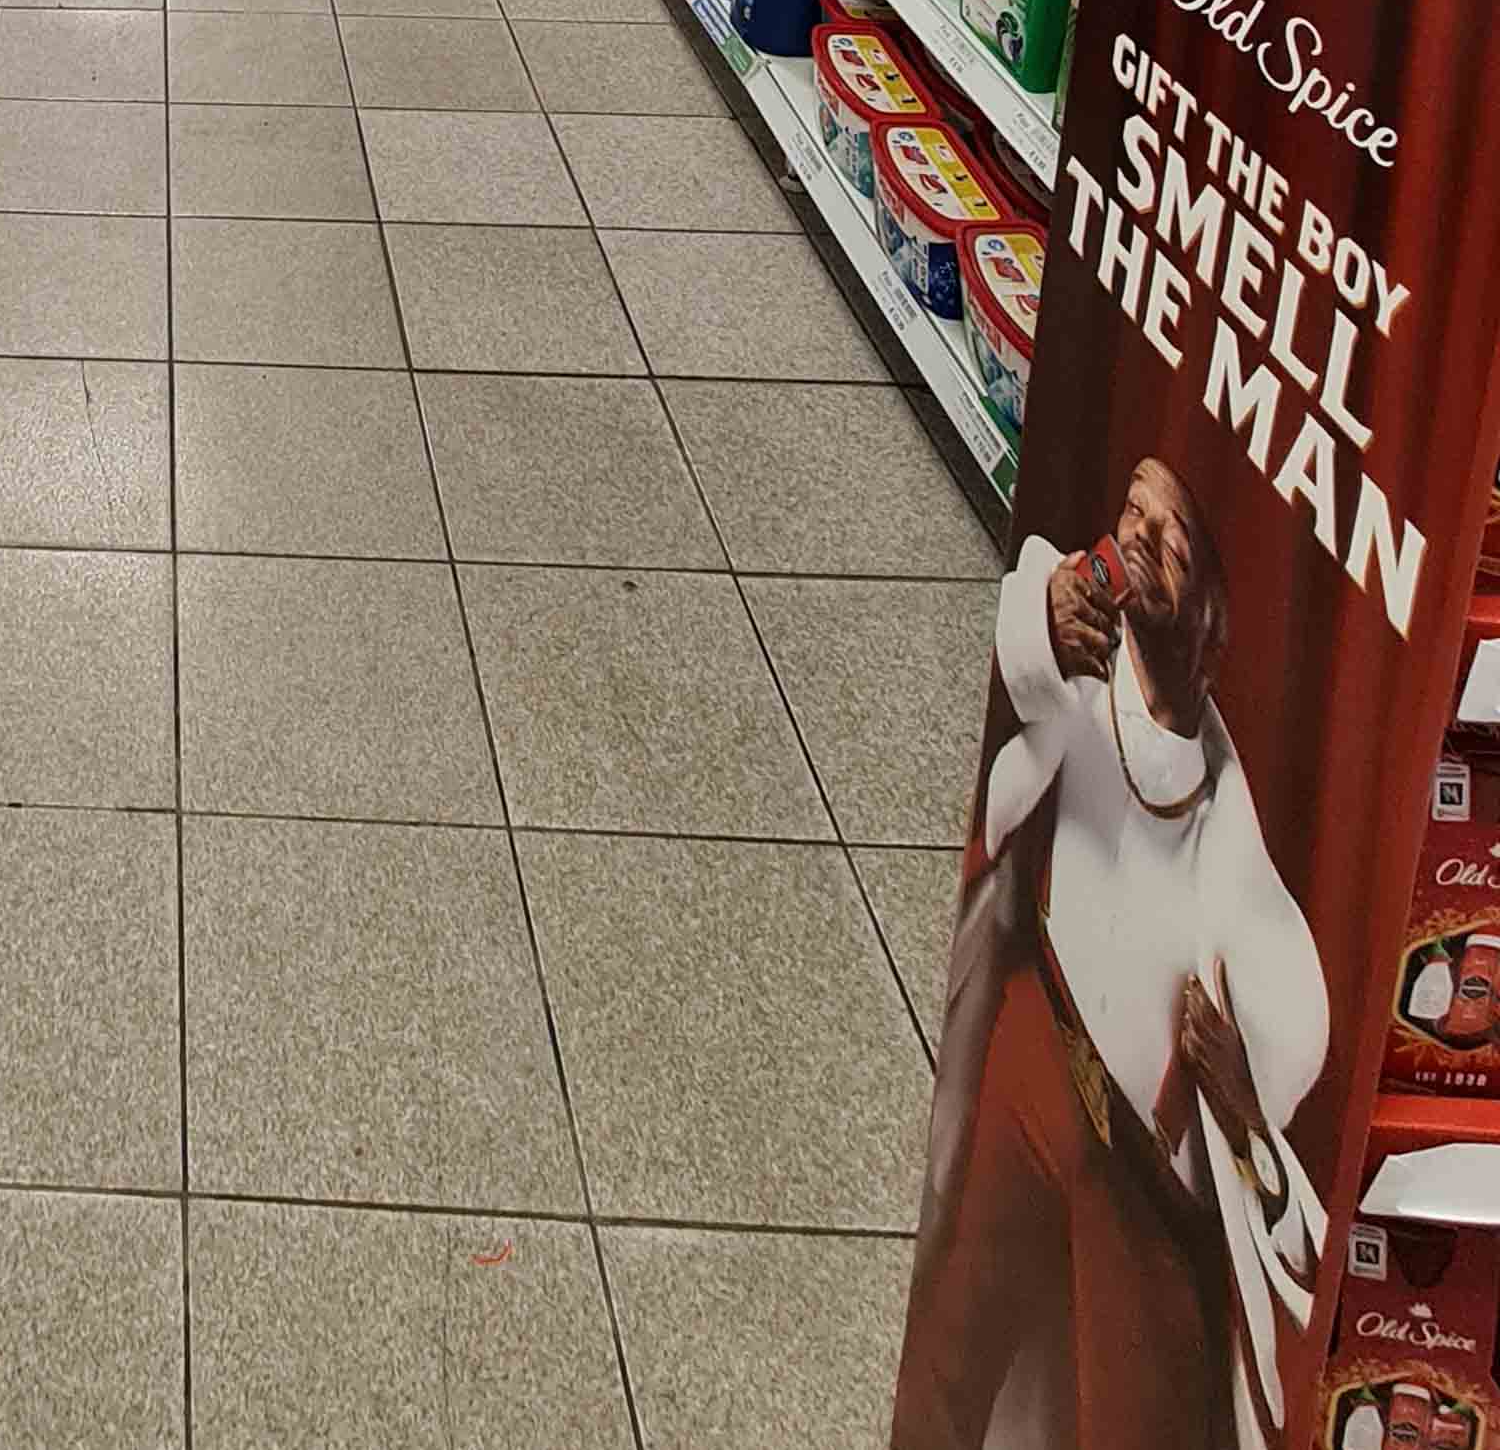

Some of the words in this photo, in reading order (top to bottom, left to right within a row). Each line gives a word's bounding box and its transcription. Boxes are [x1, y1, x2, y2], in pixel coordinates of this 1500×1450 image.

[1111, 33, 1198, 140] GIFT
[1203, 111, 1290, 235] THE
[1297, 199, 1411, 340] BOY
[1258, 17, 1399, 168] Spice
[1117, 113, 1373, 451] SMELL
[1064, 155, 1191, 370] THE
[1202, 317, 1427, 640] MAN
[1435, 858, 1489, 888] Old
[1356, 1312, 1410, 1342] Old
[1409, 1321, 1477, 1355] Spice
